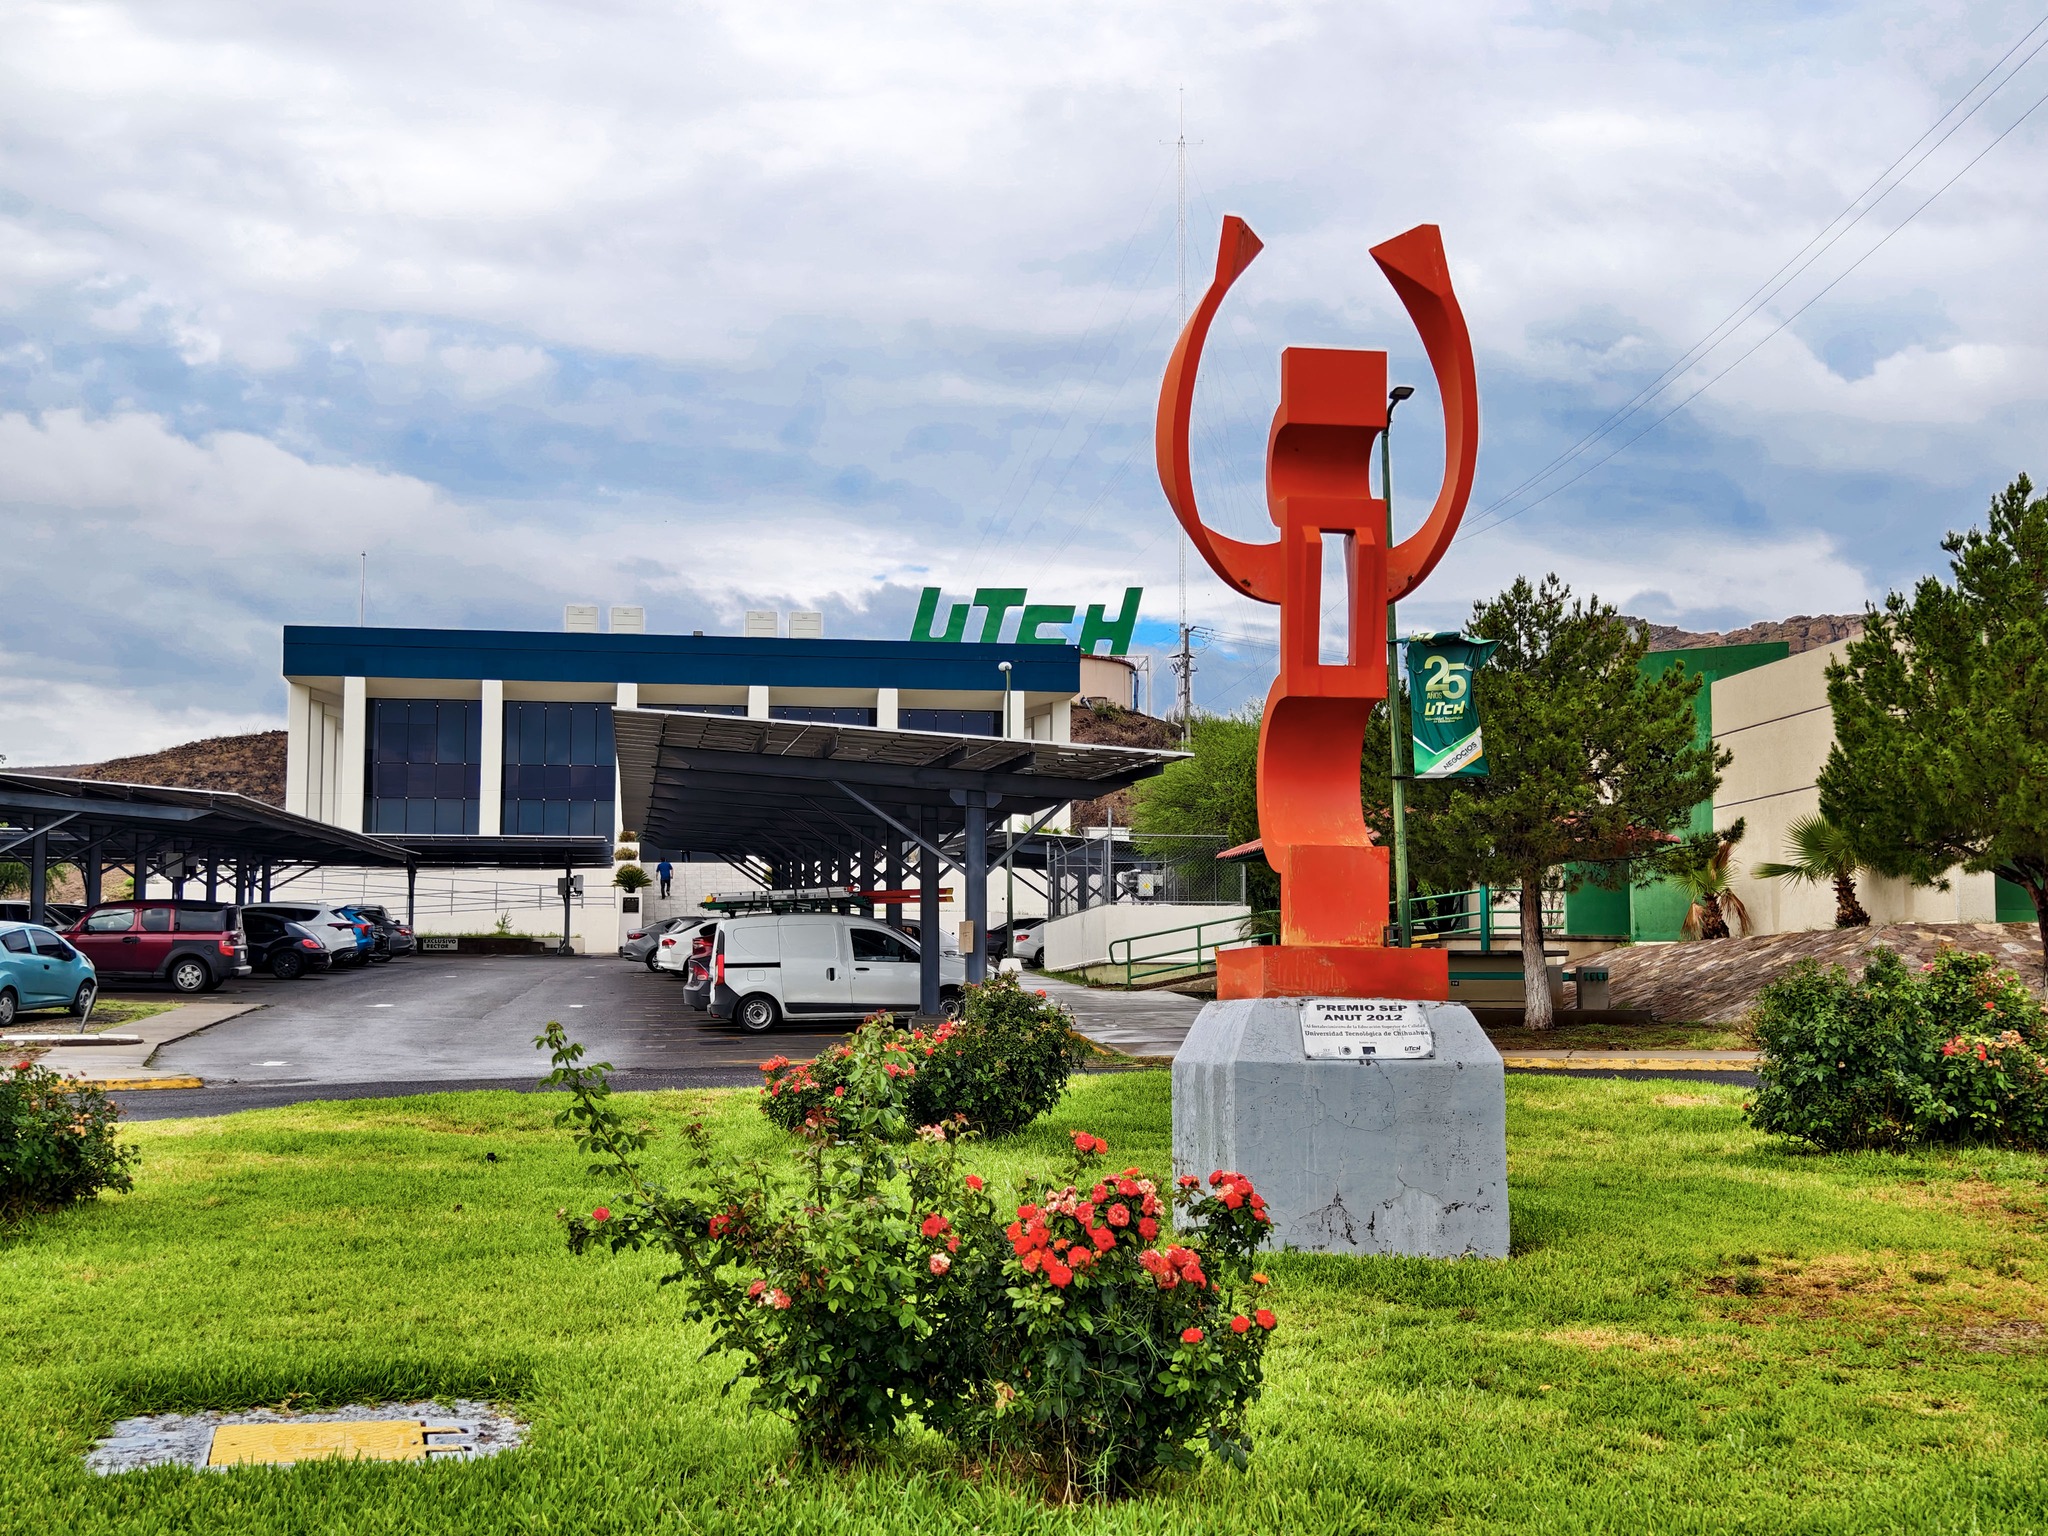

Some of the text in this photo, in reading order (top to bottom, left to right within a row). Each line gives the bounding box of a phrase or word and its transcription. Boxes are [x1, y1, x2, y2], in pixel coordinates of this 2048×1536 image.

[910, 586, 1144, 655] UTCH
[1424, 655, 1467, 699] 25
[1427, 691, 1443, 700] AÑOS
[1424, 700, 1466, 716] UTCH
[1442, 741, 1478, 770] NEGOCIOS
[1316, 1004, 1408, 1012] PREMIO SEP
